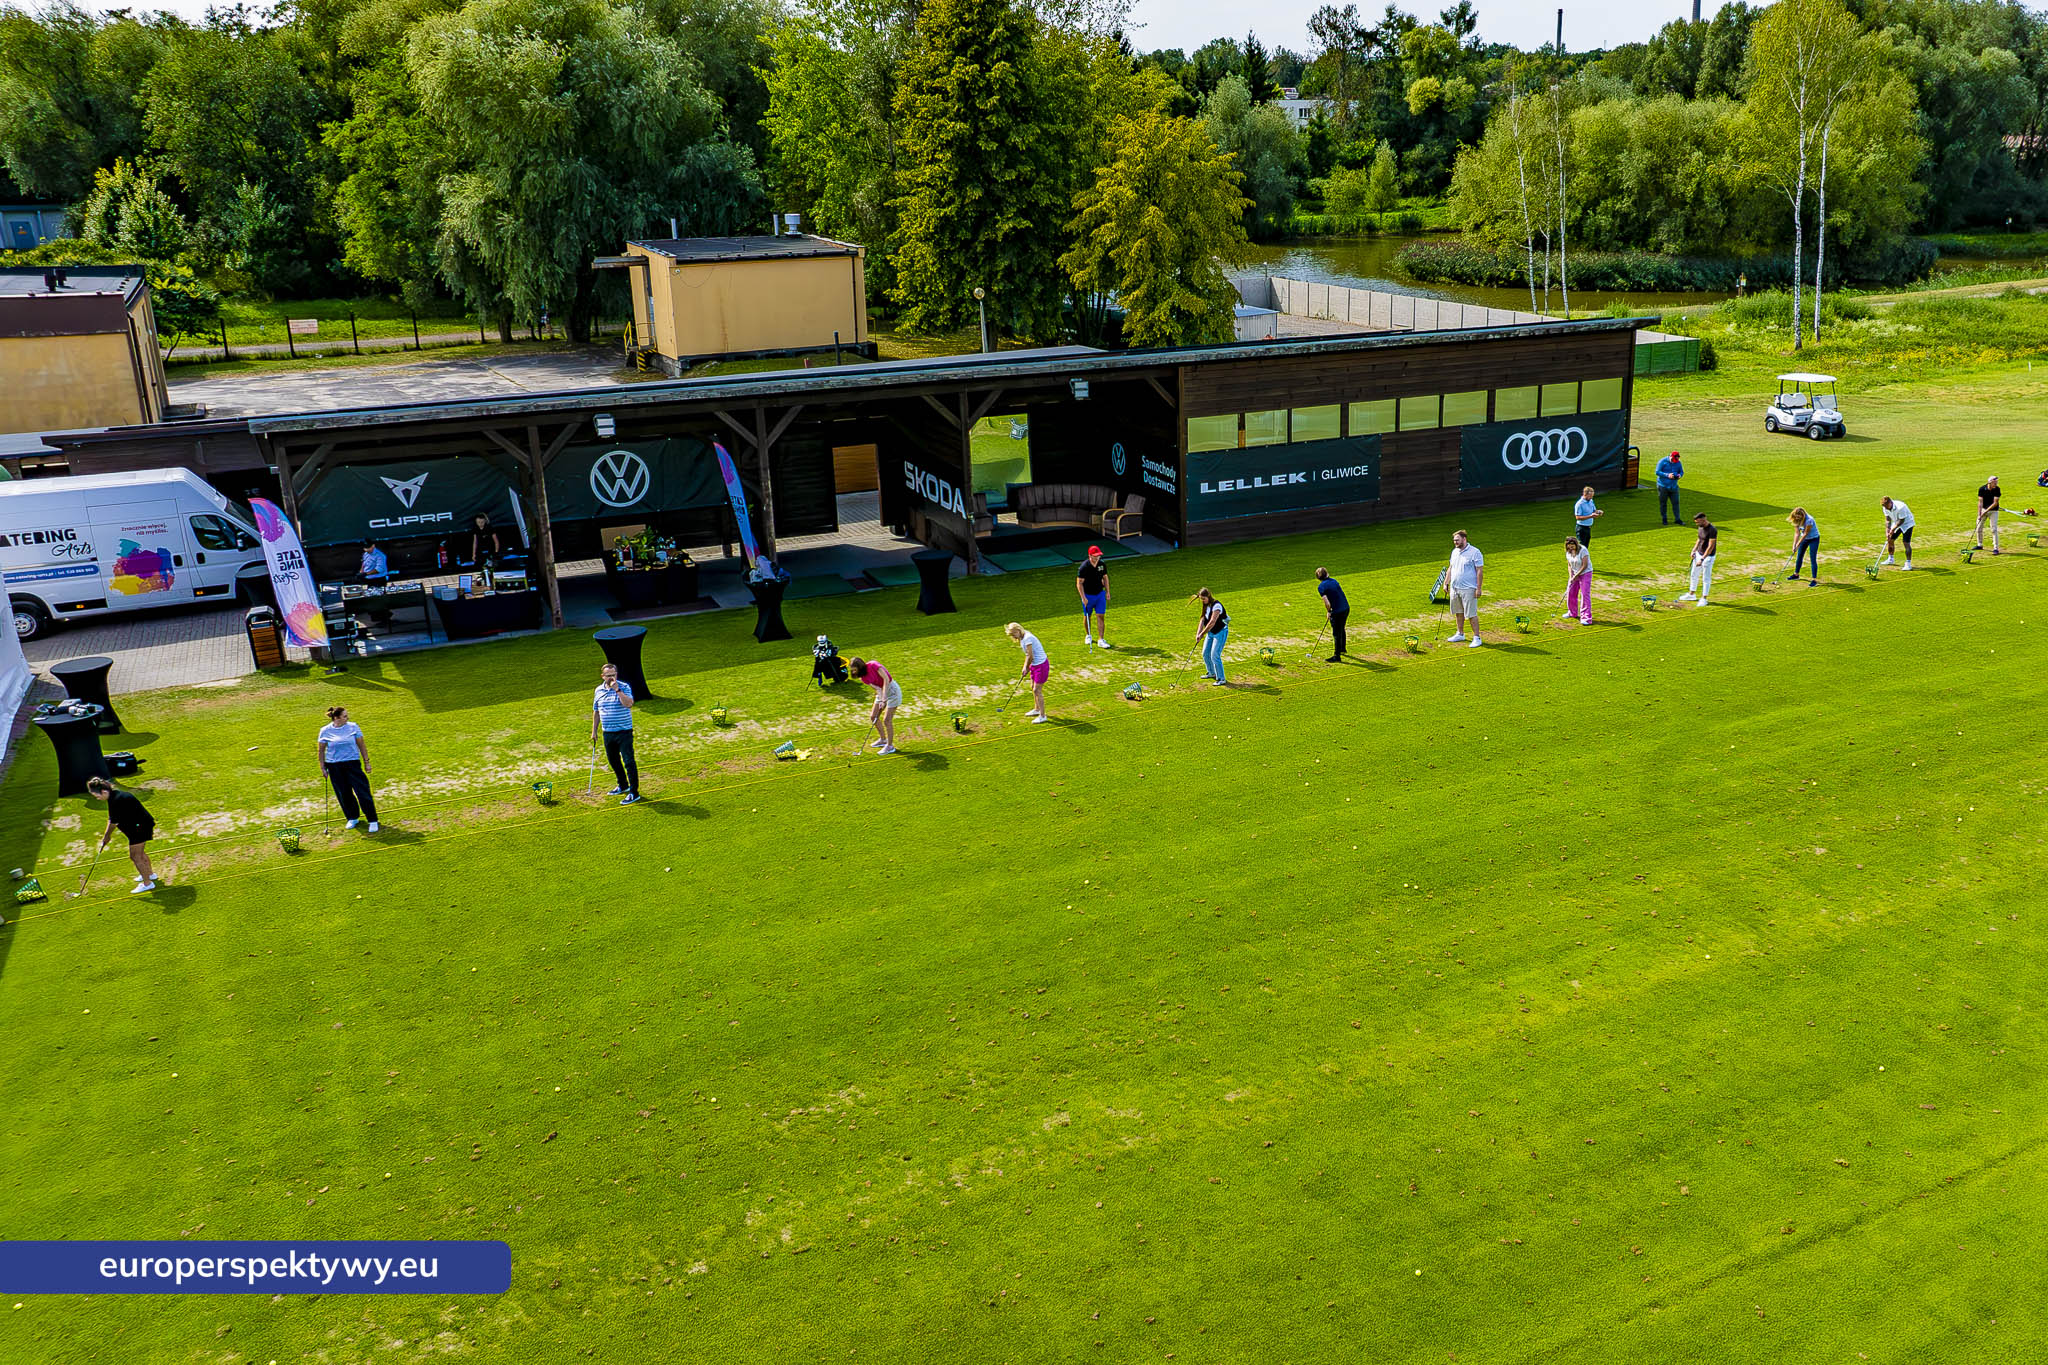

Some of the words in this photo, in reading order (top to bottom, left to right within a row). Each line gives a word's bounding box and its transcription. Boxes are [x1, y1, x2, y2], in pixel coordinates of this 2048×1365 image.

[1141, 455, 1176, 483] Samochody
[1200, 471, 1307, 494] LELLEK
[1321, 465, 1369, 481] GLIWICE
[1143, 470, 1176, 496] Dostawcze
[369, 512, 453, 528] CUPRA
[51, 541, 96, 560] Arts
